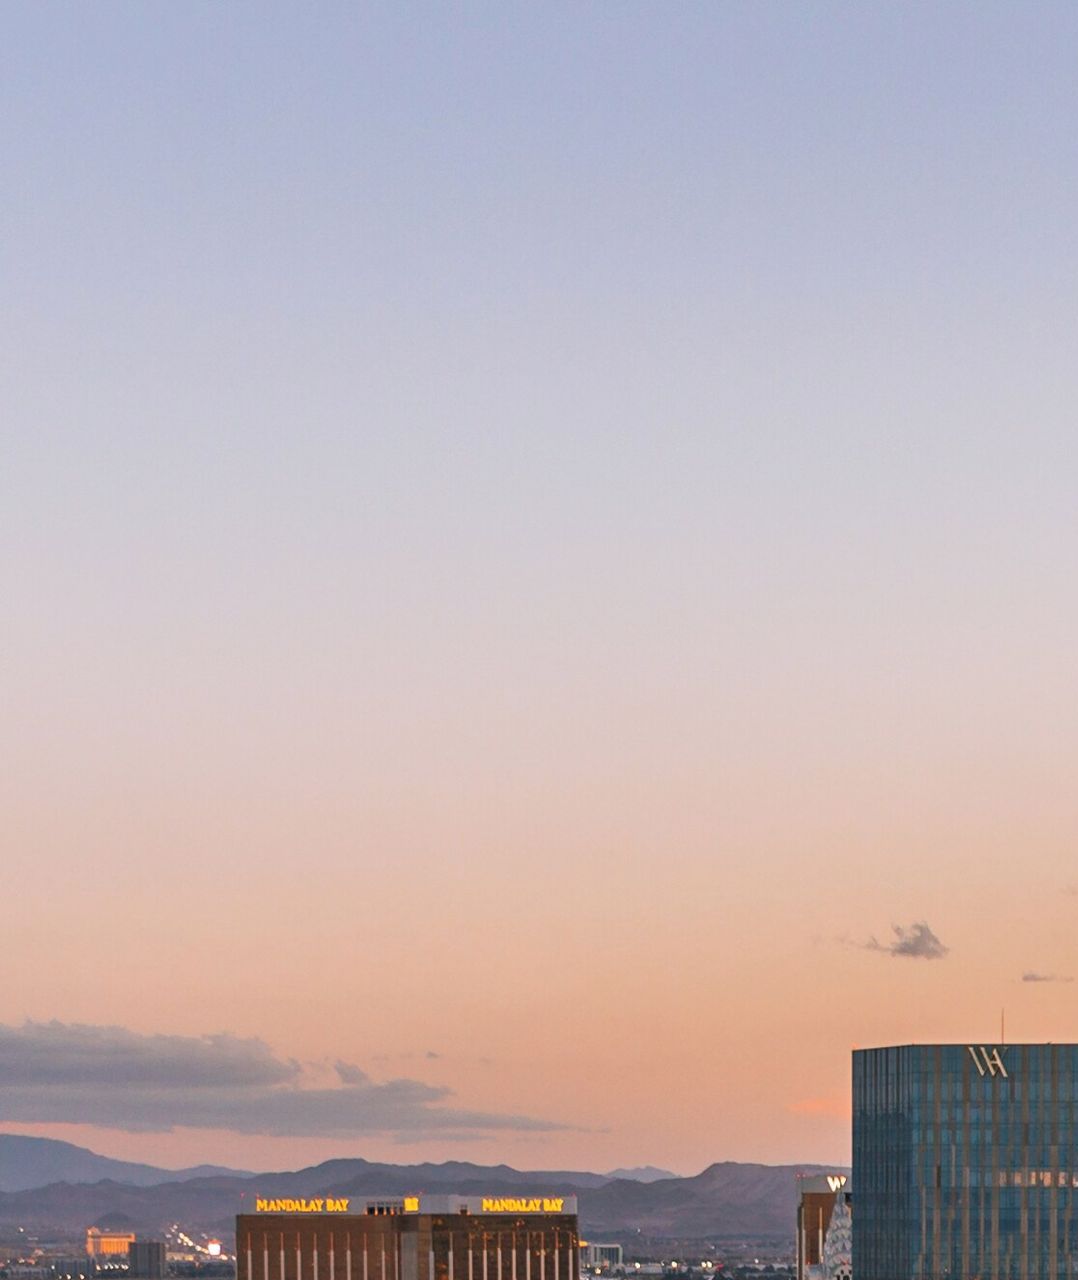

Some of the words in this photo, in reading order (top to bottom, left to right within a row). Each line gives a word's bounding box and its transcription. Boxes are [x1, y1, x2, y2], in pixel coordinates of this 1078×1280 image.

[256, 1199, 323, 1212] MANDALAY
[326, 1199, 349, 1212] BAY
[482, 1198, 542, 1212] MANDALAY
[543, 1198, 564, 1212] BAY
